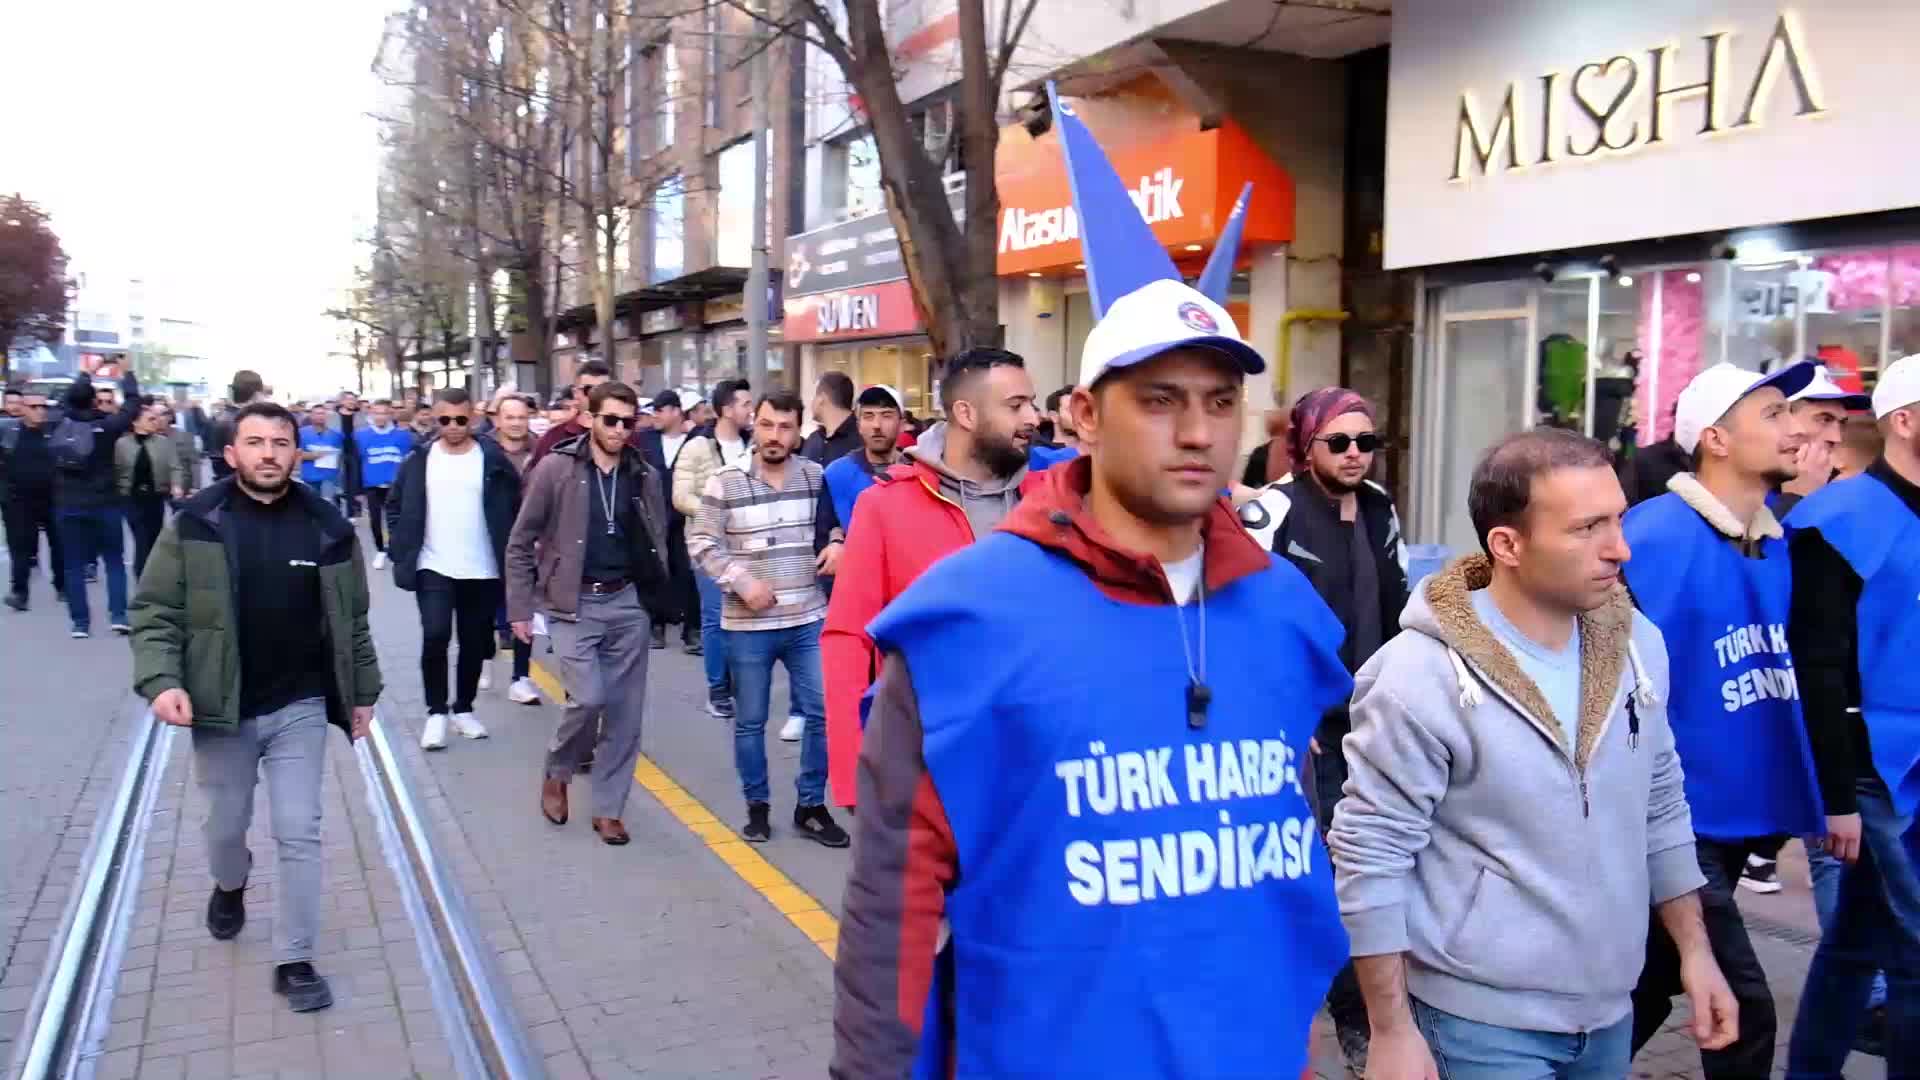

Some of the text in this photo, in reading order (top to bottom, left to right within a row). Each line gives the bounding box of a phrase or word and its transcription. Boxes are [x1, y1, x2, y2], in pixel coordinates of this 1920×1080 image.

[1447, 14, 1826, 181] MISHA
[1128, 168, 1184, 225] tik
[817, 293, 879, 333] SUWEN
[1713, 623, 1770, 669] TÜRK
[1055, 740, 1180, 817] TÜRK
[1064, 810, 1317, 906] SENDİKASI
